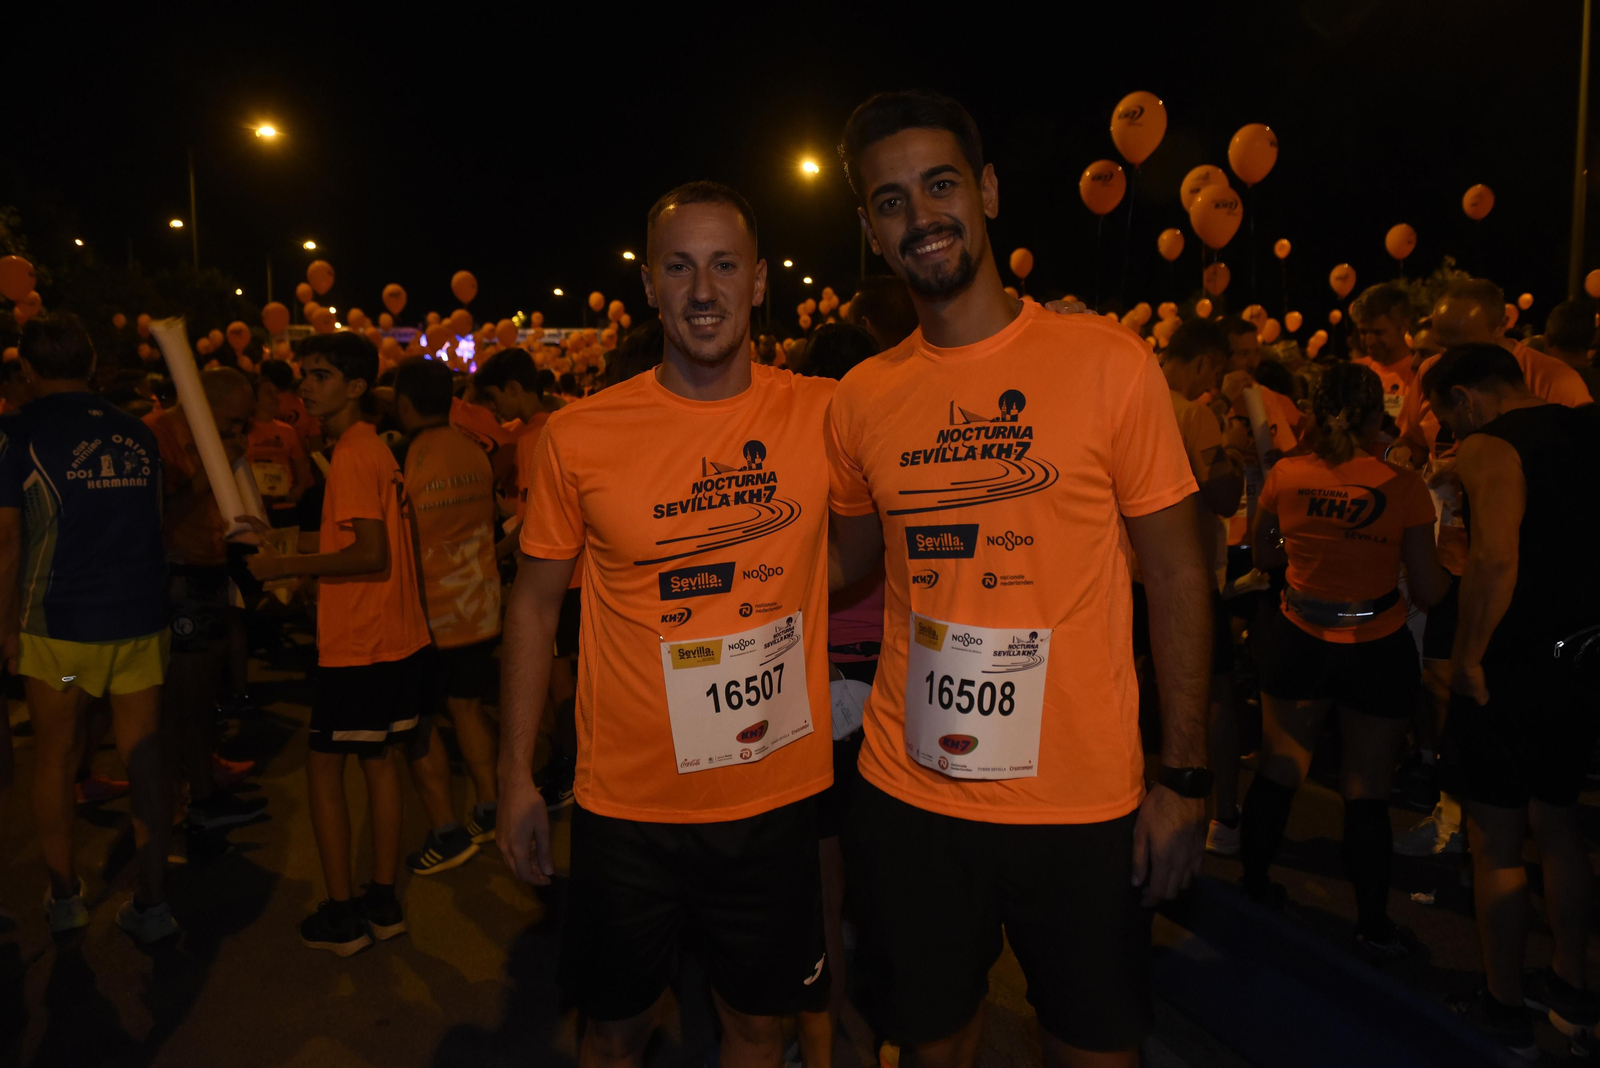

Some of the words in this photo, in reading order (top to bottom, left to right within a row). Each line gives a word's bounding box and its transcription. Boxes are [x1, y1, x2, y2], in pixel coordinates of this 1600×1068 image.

[936, 425, 1034, 444] NOCTURNA
[111, 434, 151, 476] ORIPPO
[899, 446, 977, 467] SEVILLA
[66, 469, 93, 480] DOS
[86, 478, 147, 489] HERMANAS
[691, 471, 778, 495] NOCTURNA
[1297, 488, 1349, 498] NOCTURNA
[653, 495, 731, 519] SEVILLA
[1344, 530, 1388, 543] SEVILLA
[773, 626, 795, 640] NOCTURNA
[764, 636, 784, 649] SEVILLA
[992, 649, 1021, 657] SEVILLA
[706, 662, 785, 713] 16507
[925, 670, 1015, 716] 16508
